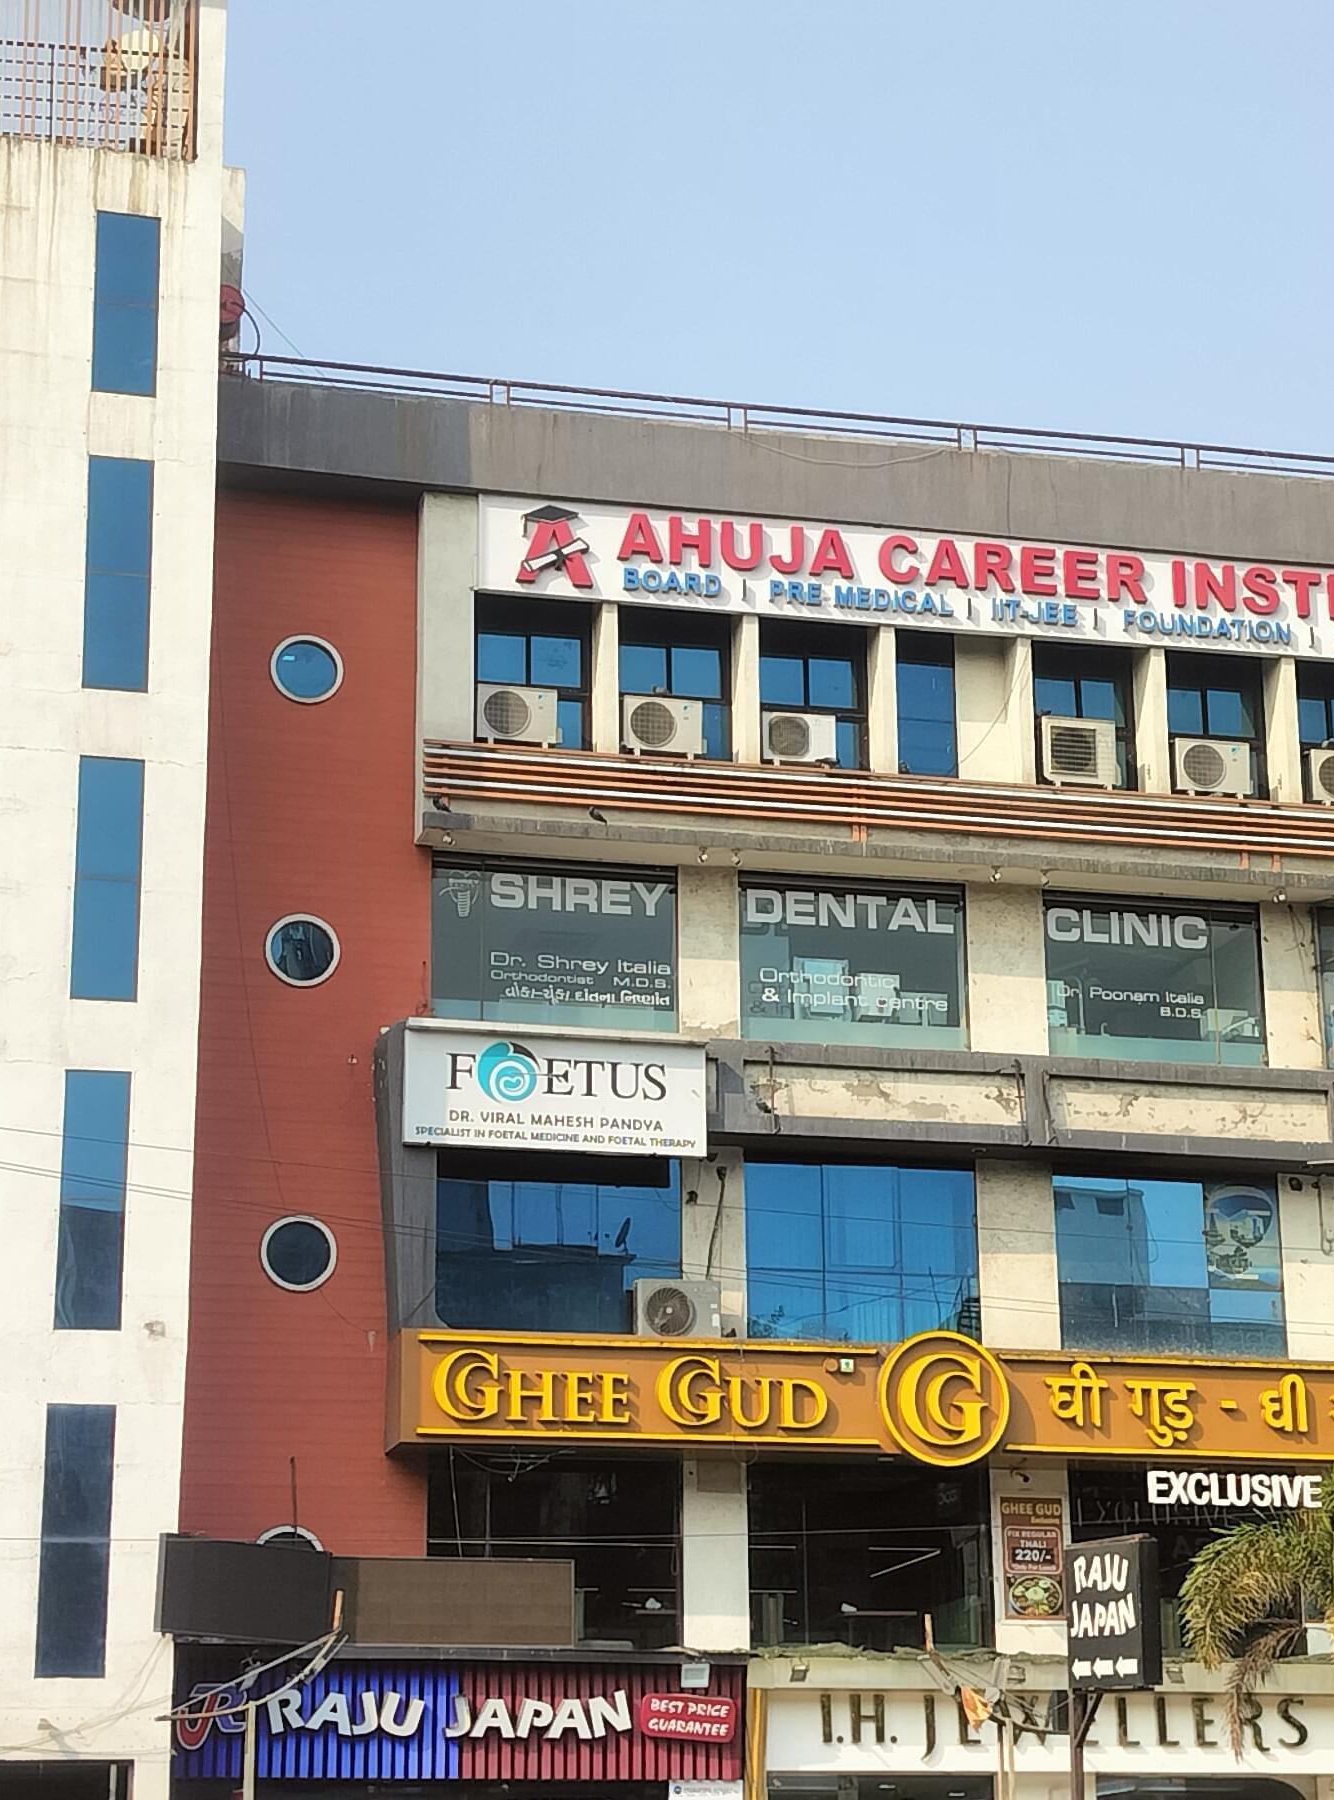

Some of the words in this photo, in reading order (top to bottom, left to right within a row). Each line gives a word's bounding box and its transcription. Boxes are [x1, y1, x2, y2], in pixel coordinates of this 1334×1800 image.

[616, 511, 855, 579] AHUJA
[877, 534, 1146, 604] CAREER
[622, 566, 722, 599] BOARD
[769, 579, 823, 605] PRE
[834, 585, 955, 618] MEDICAL
[990, 597, 1078, 627] IIT-JEE
[1123, 608, 1292, 645] FOUNDATION
[489, 872, 669, 917] SHREY
[746, 887, 955, 935] DENTAL
[1046, 906, 1209, 950] CLINIC
[490, 951, 527, 968] Dr.
[537, 954, 610, 975] Shrey
[617, 959, 672, 976] Italia
[490, 969, 595, 986] Orthodontist
[613, 976, 672, 990] M.D.S.
[759, 967, 895, 989] Orthodontic
[761, 987, 780, 1003] &
[787, 989, 868, 1008] Implant
[875, 995, 949, 1012] centre
[1089, 986, 1160, 1003] Poonam
[1165, 990, 1205, 1005] Italia
[448, 1109, 475, 1124] DR.
[480, 1111, 525, 1126] VIRAL
[530, 1113, 595, 1130] MAHESH
[600, 1117, 664, 1133] PANDYA
[414, 1125, 472, 1139] SPECIALIST
[474, 1128, 486, 1139] IN
[488, 1129, 528, 1142] FOETAL
[530, 1131, 580, 1144] MEDICINE
[582, 1134, 606, 1145] AND
[608, 1135, 647, 1148] FOETAL
[649, 1136, 697, 1150] THERAPY
[431, 1348, 632, 1424] GHEE
[657, 1355, 830, 1430] GUD
[1044, 1362, 1108, 1428] घी
[1147, 1469, 1323, 1508] EXCLUSIVE
[1001, 1502, 1034, 1515] GHEE
[1035, 1503, 1062, 1516] GUD
[1015, 1549, 1052, 1562] 220/-
[1020, 1540, 1047, 1549] THALI
[1073, 1553, 1129, 1594] RAJU
[1070, 1592, 1137, 1639] JAPAN
[267, 1687, 427, 1738] RAJU
[444, 1689, 633, 1740] JAPAN
[650, 1698, 685, 1714] BEST
[687, 1702, 730, 1718] PRICE
[648, 1717, 730, 1737] GUARANTEE
[820, 1693, 898, 1744] I.H.
[921, 1693, 1310, 1762] JEWLLERS
